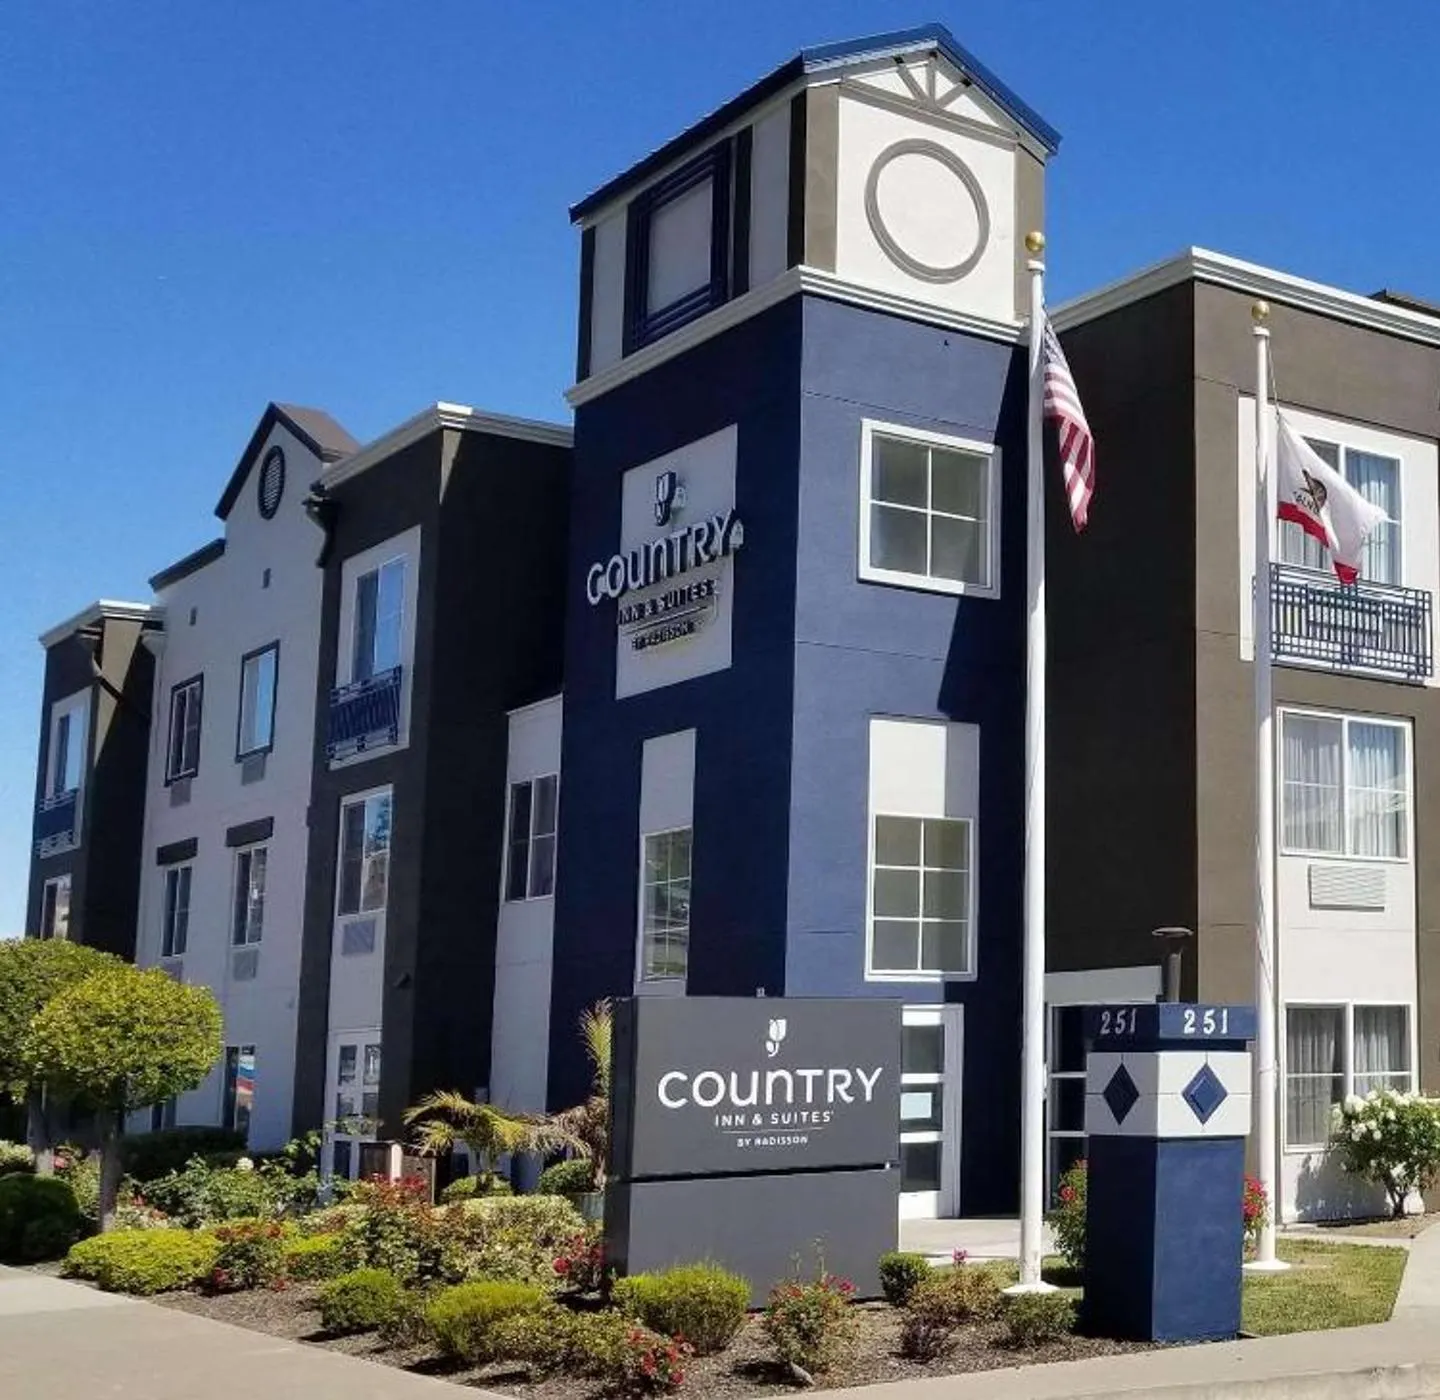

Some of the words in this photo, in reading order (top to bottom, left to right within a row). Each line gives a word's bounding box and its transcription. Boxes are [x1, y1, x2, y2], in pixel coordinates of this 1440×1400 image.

[587, 508, 736, 605] COUNTRY
[1100, 1009, 1137, 1034] 251
[1183, 1008, 1228, 1034] 251
[657, 1067, 883, 1108] COUNTRY
[715, 1113, 746, 1127] INN
[751, 1113, 763, 1126] &
[770, 1110, 832, 1125] SUITES
[736, 1137, 752, 1148] BY
[753, 1135, 809, 1147] RADISSON
